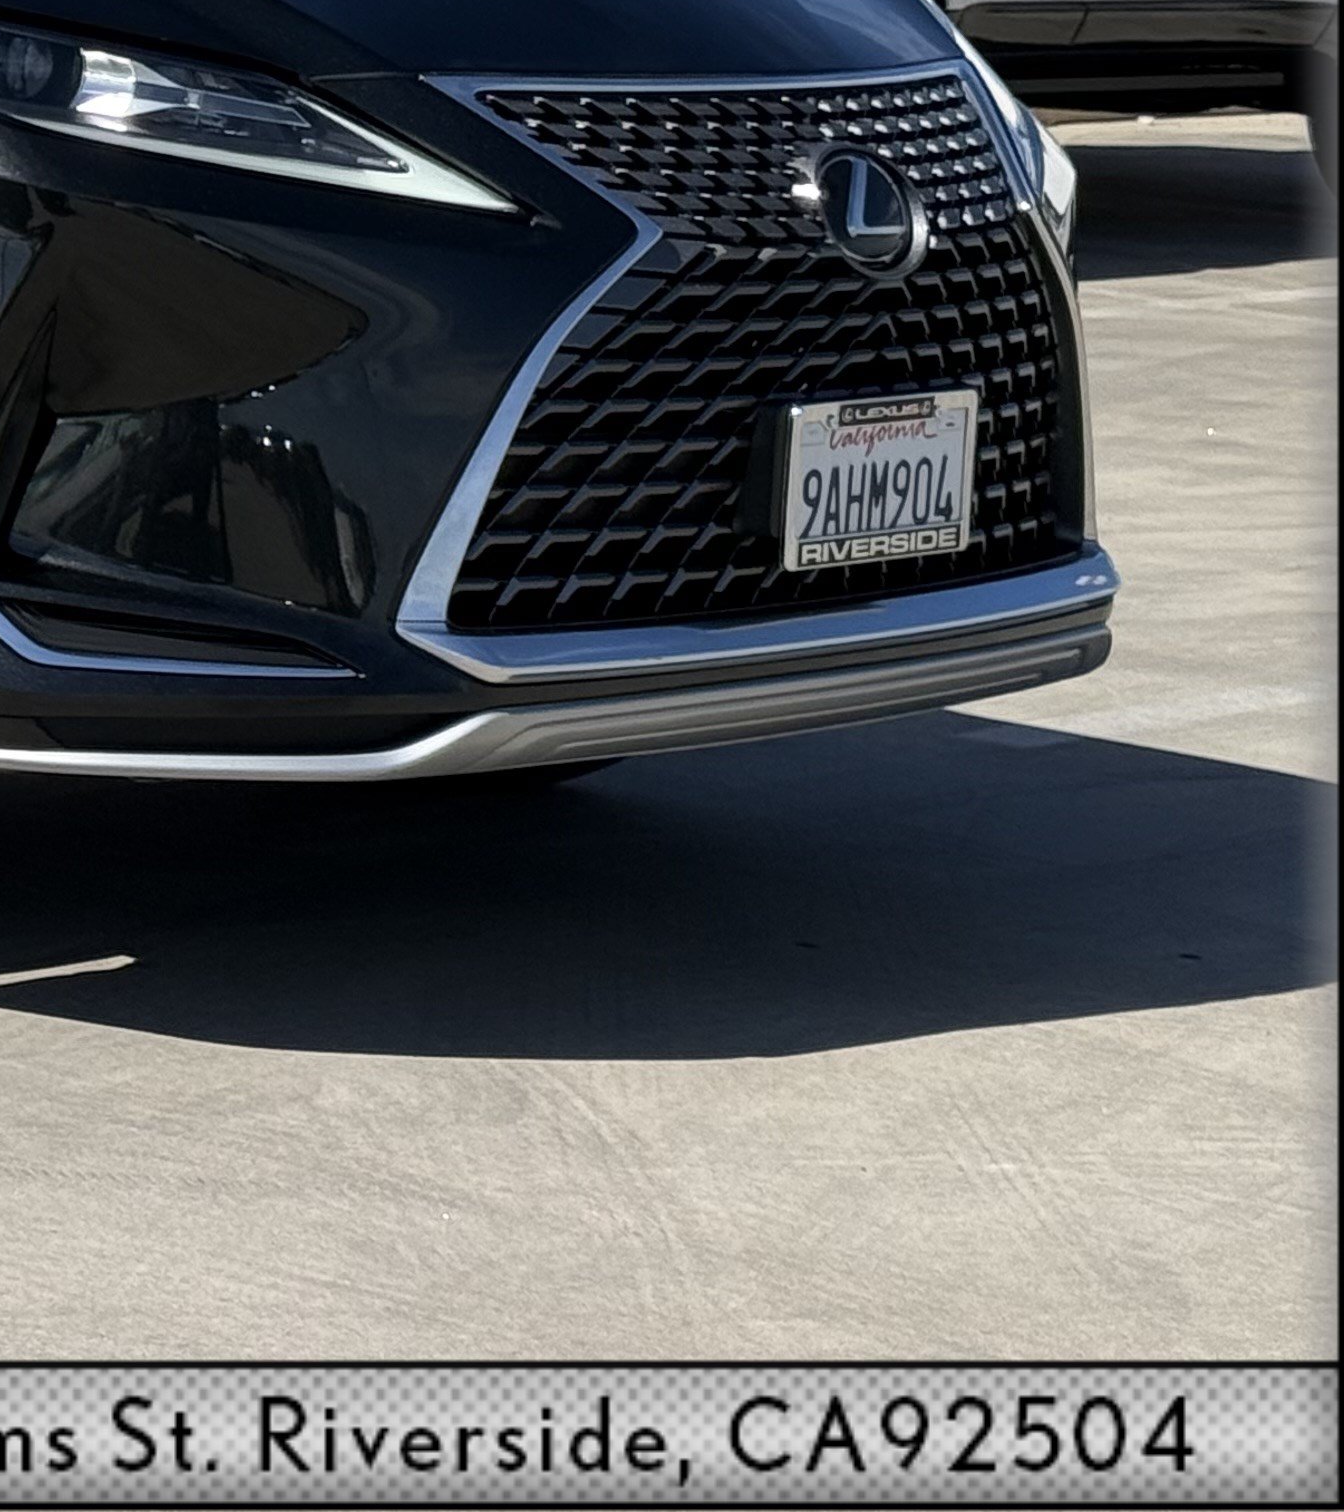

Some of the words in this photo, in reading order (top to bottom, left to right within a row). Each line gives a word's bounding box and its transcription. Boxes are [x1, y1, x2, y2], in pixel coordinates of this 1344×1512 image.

[854, 404, 920, 421] LEXUS
[829, 420, 938, 458] California
[799, 453, 954, 539] 9AHM904
[800, 526, 959, 566] RIVERSIDE
